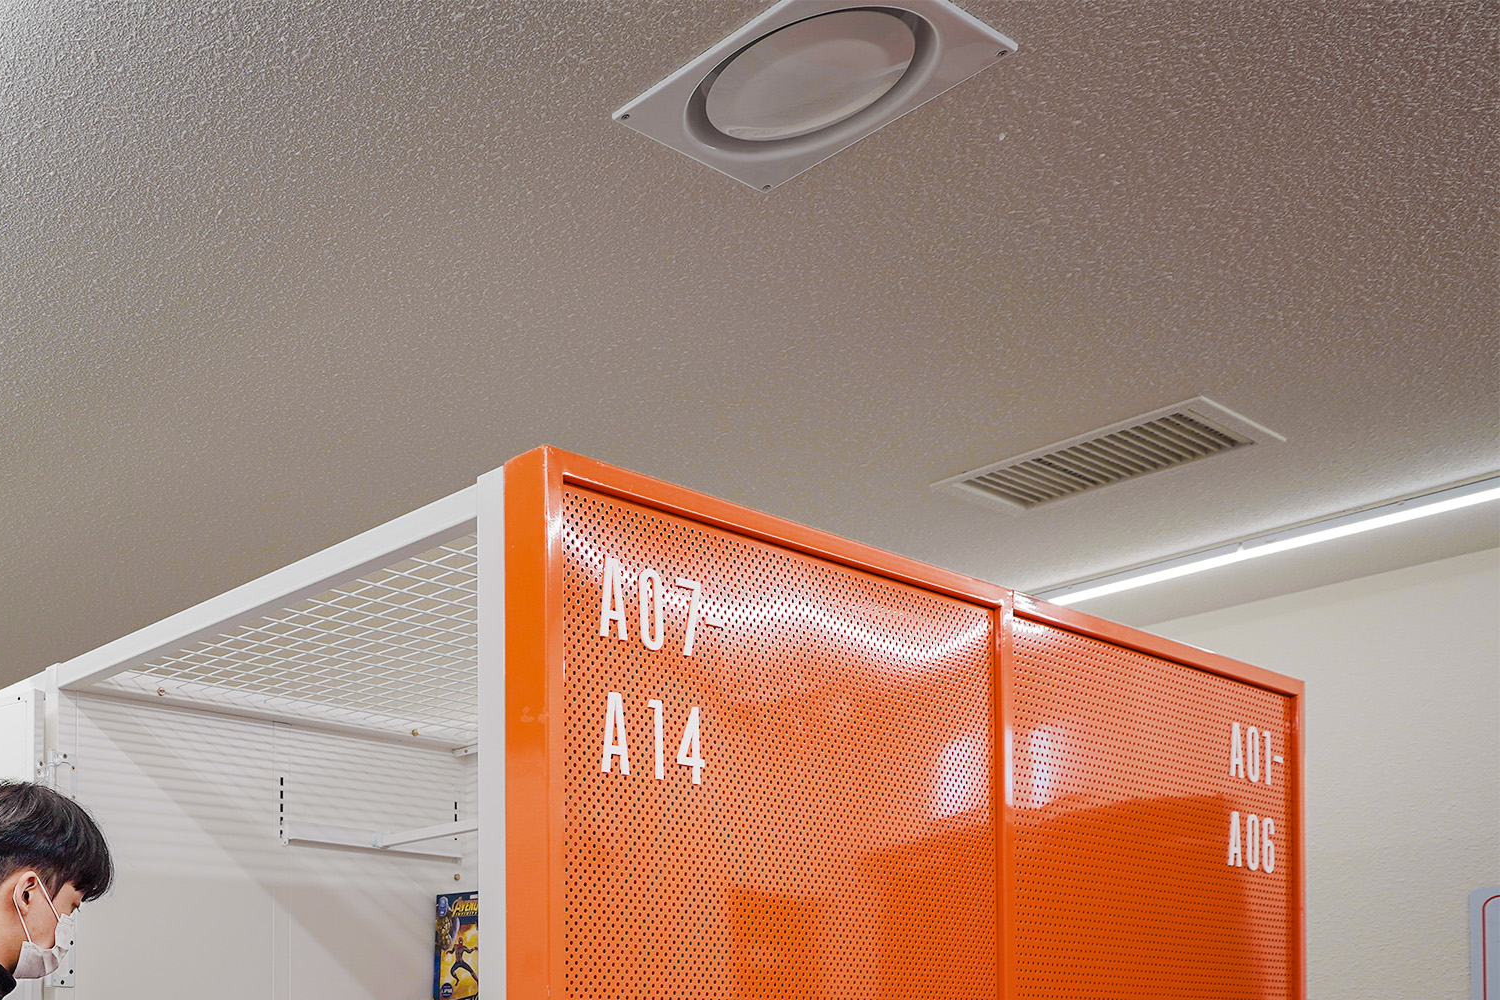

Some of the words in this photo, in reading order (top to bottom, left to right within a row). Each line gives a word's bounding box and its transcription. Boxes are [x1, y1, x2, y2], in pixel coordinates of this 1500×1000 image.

[599, 557, 725, 656] A07-
[601, 692, 706, 785] A14
[1230, 722, 1284, 786] A01-
[1227, 811, 1275, 874] A06
